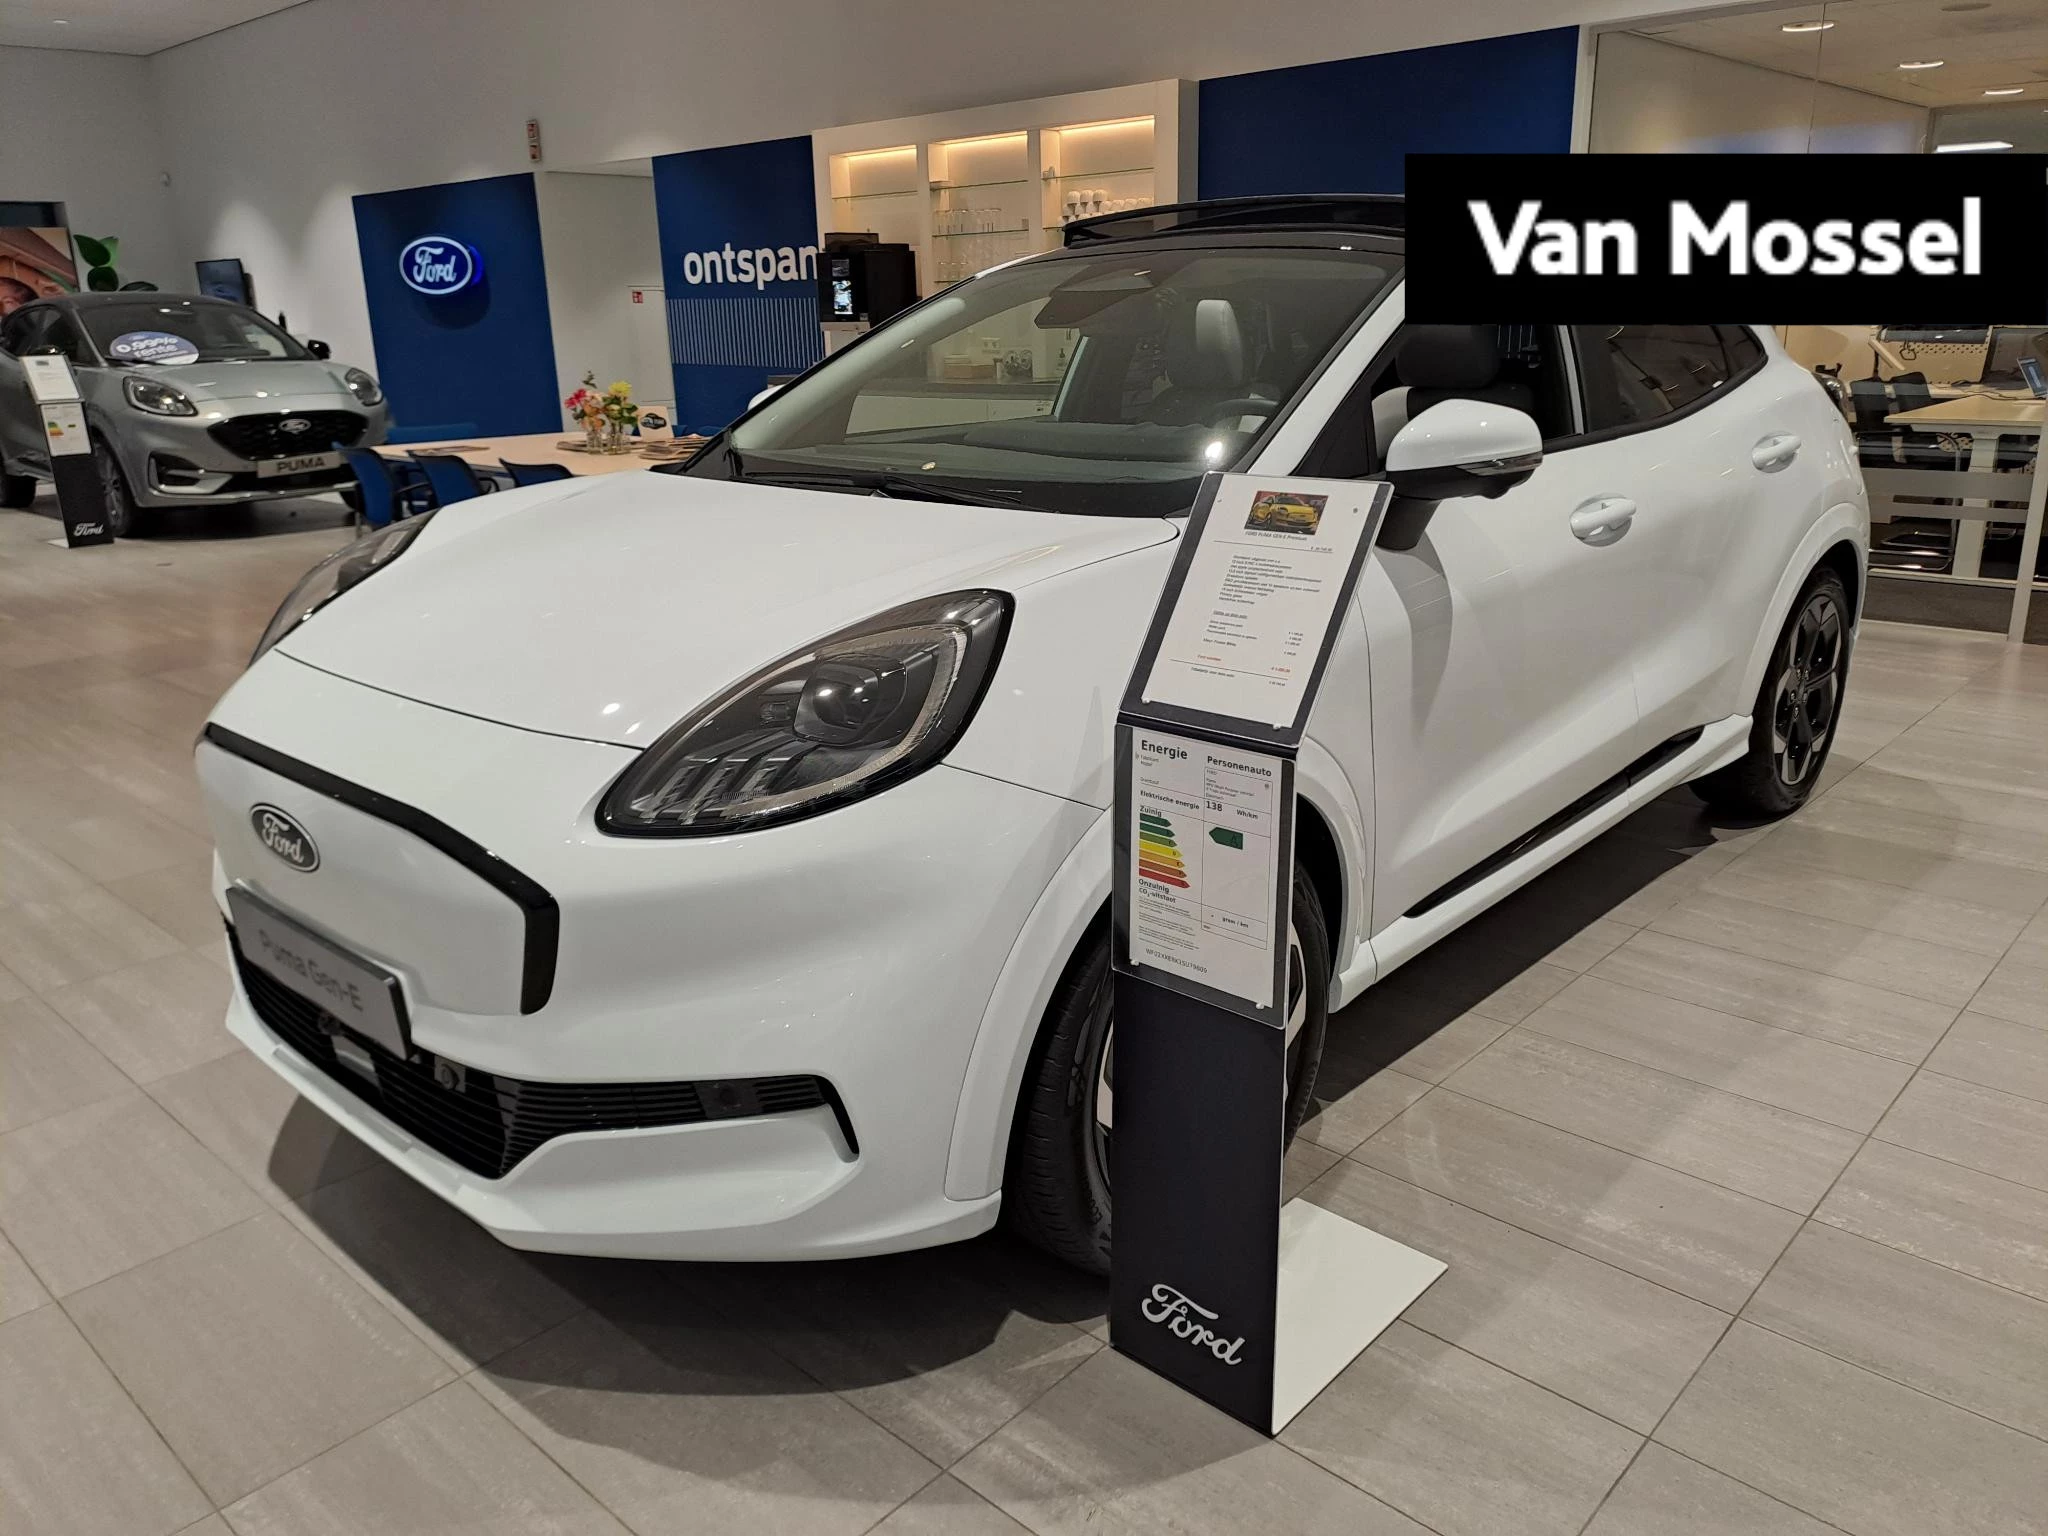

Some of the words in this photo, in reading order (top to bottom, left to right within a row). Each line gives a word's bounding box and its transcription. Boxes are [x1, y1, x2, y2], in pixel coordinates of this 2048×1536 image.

[412, 246, 458, 283] Ford
[683, 242, 818, 291] ontspan
[277, 456, 325, 473] PUMA
[73, 522, 104, 537] Ford
[1141, 740, 1188, 759] Energie
[1207, 755, 1272, 777] Personenauto
[1139, 805, 1162, 818] Zuinig
[1140, 790, 1174, 803] Elektrische
[1175, 799, 1200, 810] energie
[1205, 800, 1223, 812] 138
[1236, 809, 1259, 820] Wh/km
[261, 812, 305, 863] Ford
[1138, 878, 1170, 894] Onzuinig
[258, 927, 308, 979] Puma
[307, 959, 364, 1013] Gen-E
[1141, 1283, 1246, 1365] Ford
